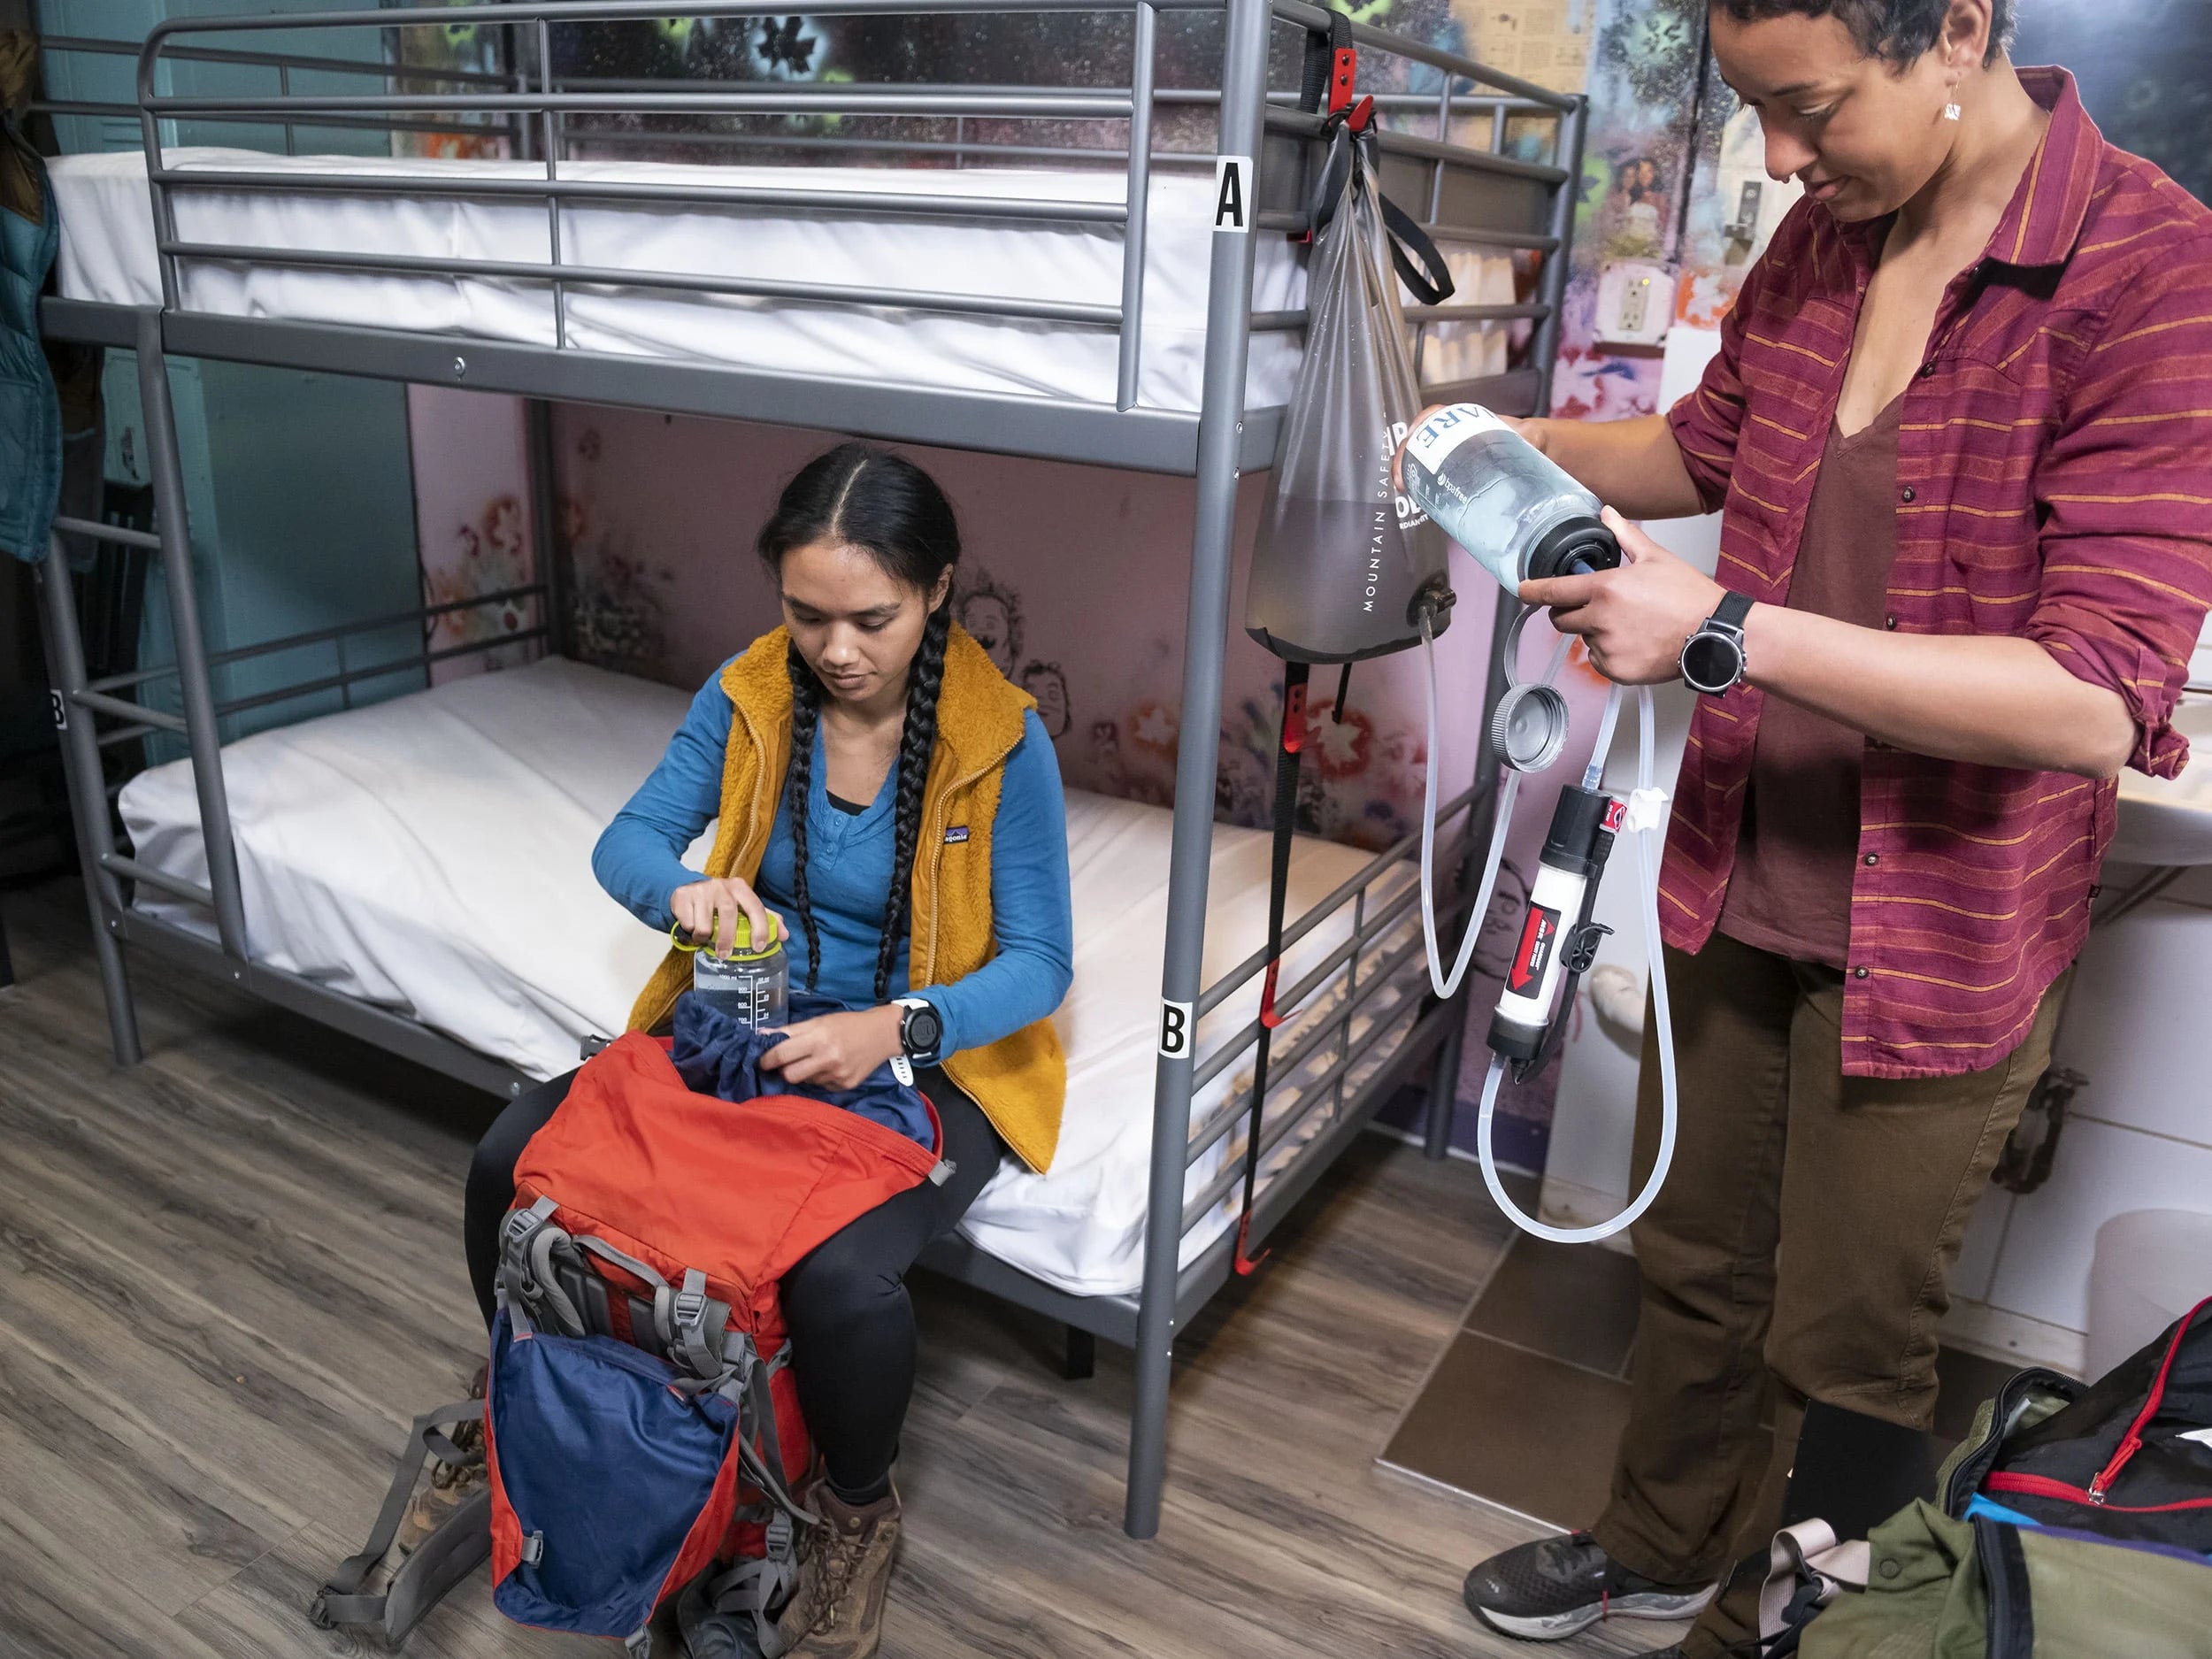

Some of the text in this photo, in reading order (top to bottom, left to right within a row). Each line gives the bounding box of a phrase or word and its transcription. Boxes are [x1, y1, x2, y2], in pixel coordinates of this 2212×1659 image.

[1216, 163, 1243, 227] A
[1416, 406, 1495, 449] ARE
[1363, 430, 1390, 612] MOUNTAIN SAFETY
[1162, 1003, 1185, 1053] B
